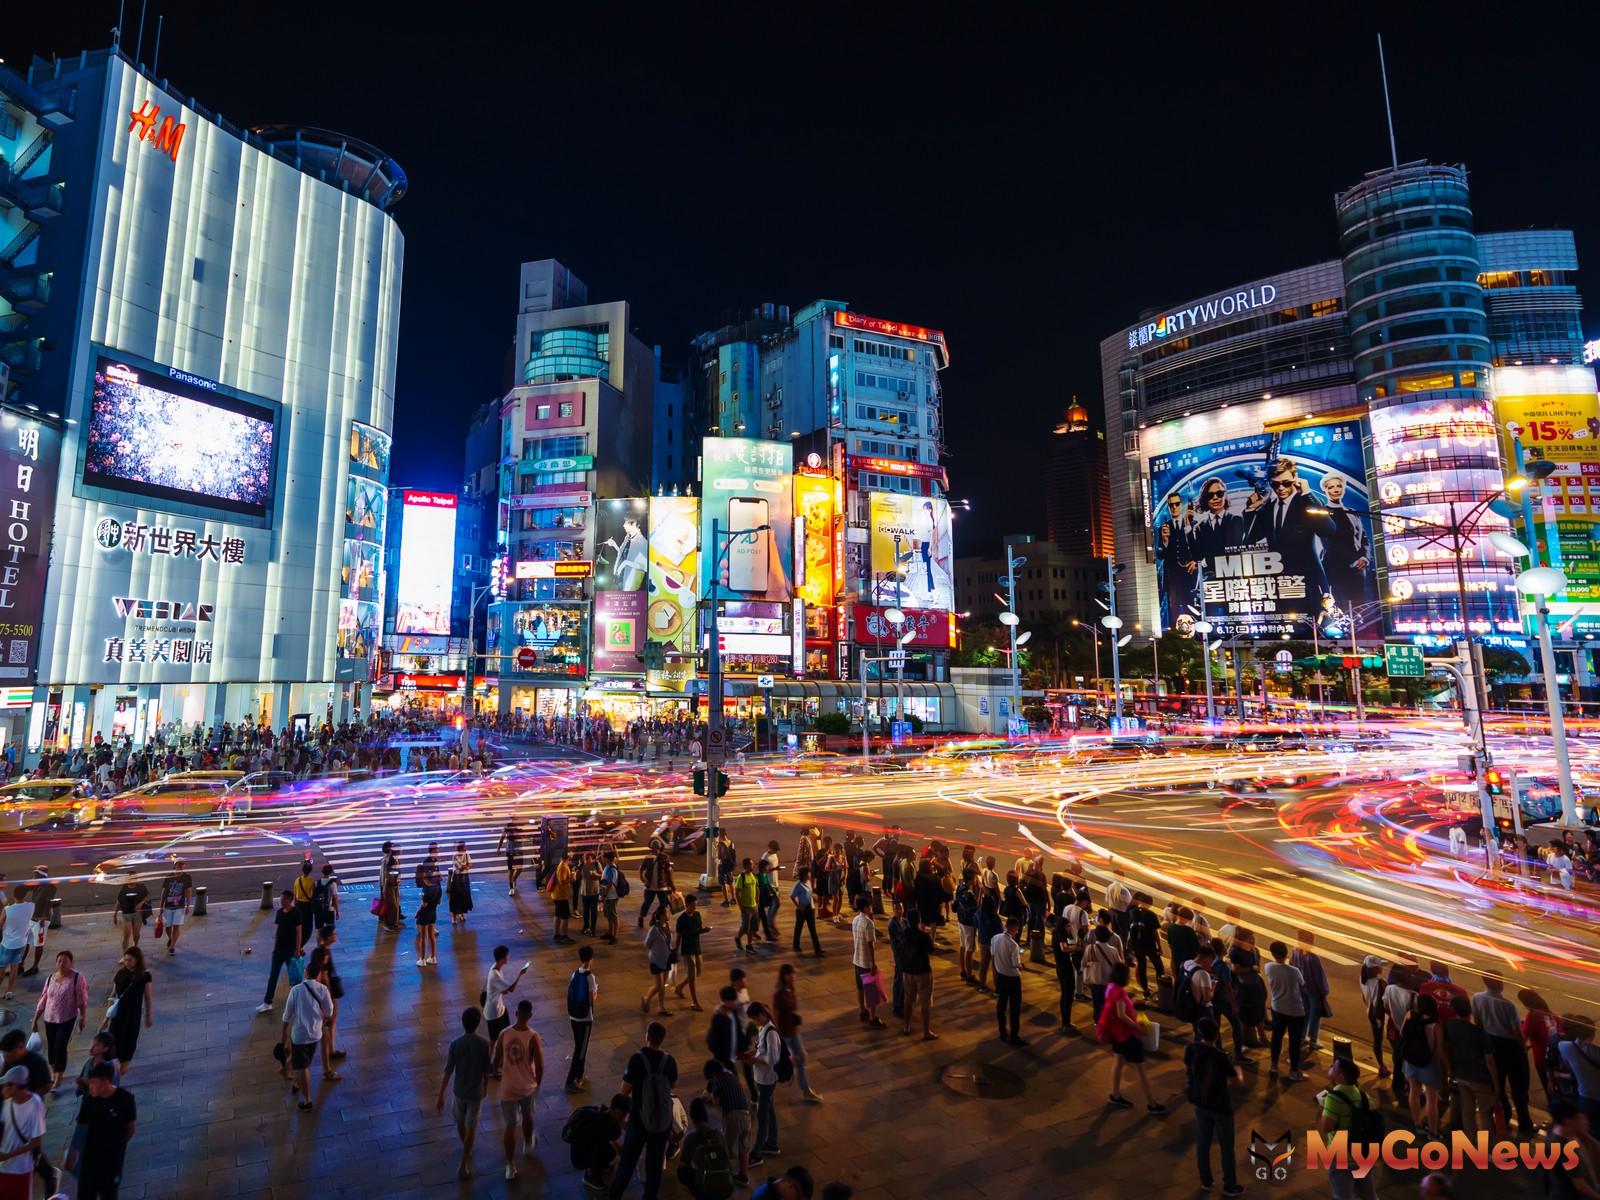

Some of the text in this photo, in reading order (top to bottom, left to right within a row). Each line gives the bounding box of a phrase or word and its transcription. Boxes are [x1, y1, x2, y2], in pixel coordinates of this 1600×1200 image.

[128, 100, 186, 162] H&M
[848, 315, 867, 326] Diary
[877, 321, 898, 332] Taipei
[1148, 285, 1276, 342] PARTYWORLD
[169, 367, 217, 391] Panasonic
[1526, 420, 1574, 441] 15%
[407, 494, 454, 506] Apollo Taipei
[0, 428, 40, 608] 明日 HOTEL
[122, 520, 246, 565] 新世界大樓
[1214, 551, 1285, 579] MIB
[1203, 575, 1306, 603] 星際戰警
[112, 597, 214, 622] WESTAR
[104, 637, 213, 665] 真善美劇院
